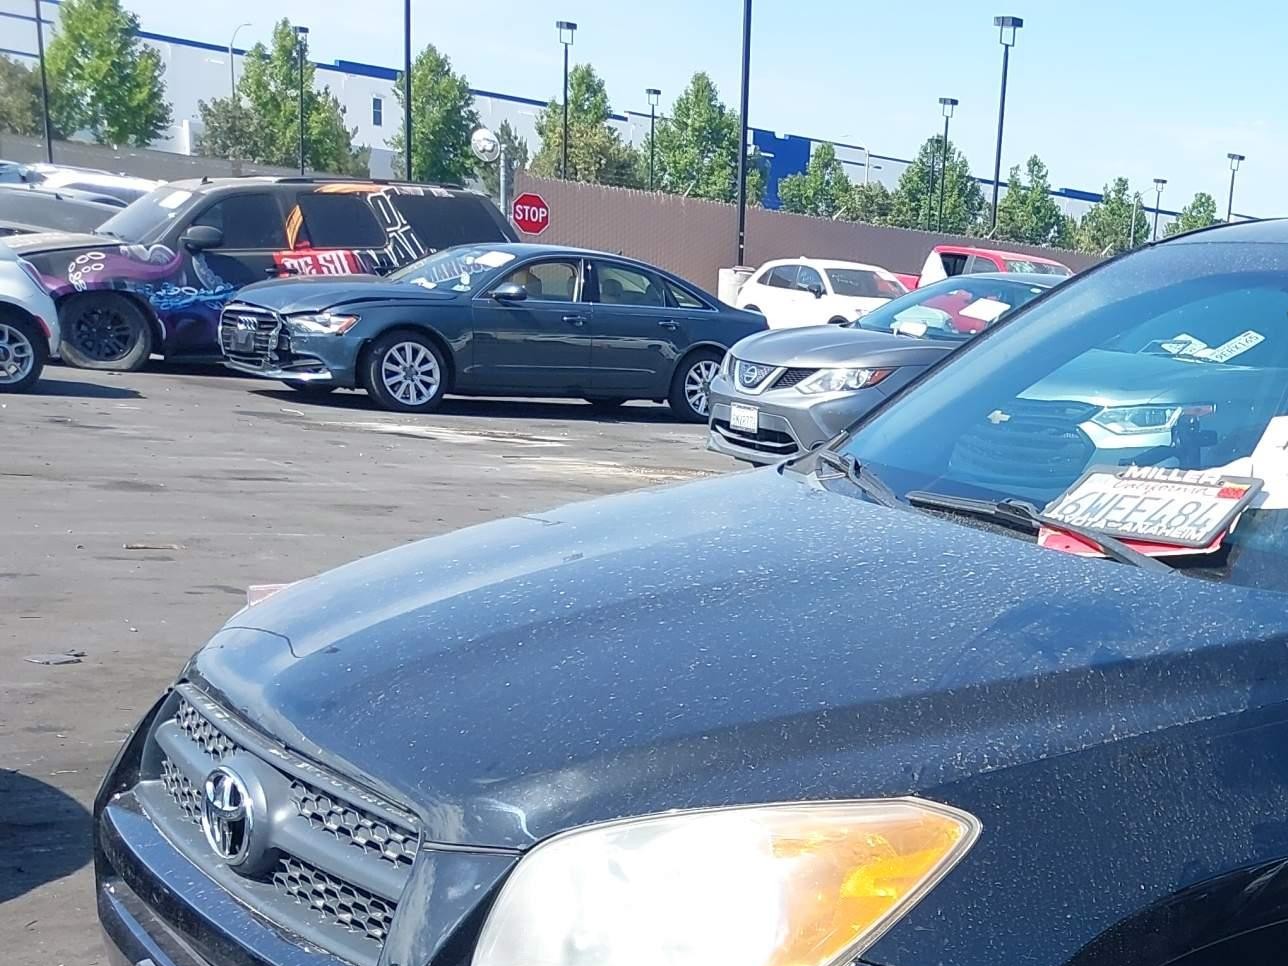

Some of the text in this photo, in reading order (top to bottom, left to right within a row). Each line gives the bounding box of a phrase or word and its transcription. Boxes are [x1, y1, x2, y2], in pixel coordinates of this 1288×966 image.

[514, 204, 548, 223] STOP
[1124, 465, 1219, 485] MILLER
[1119, 522, 1209, 541] ANAHEIM
